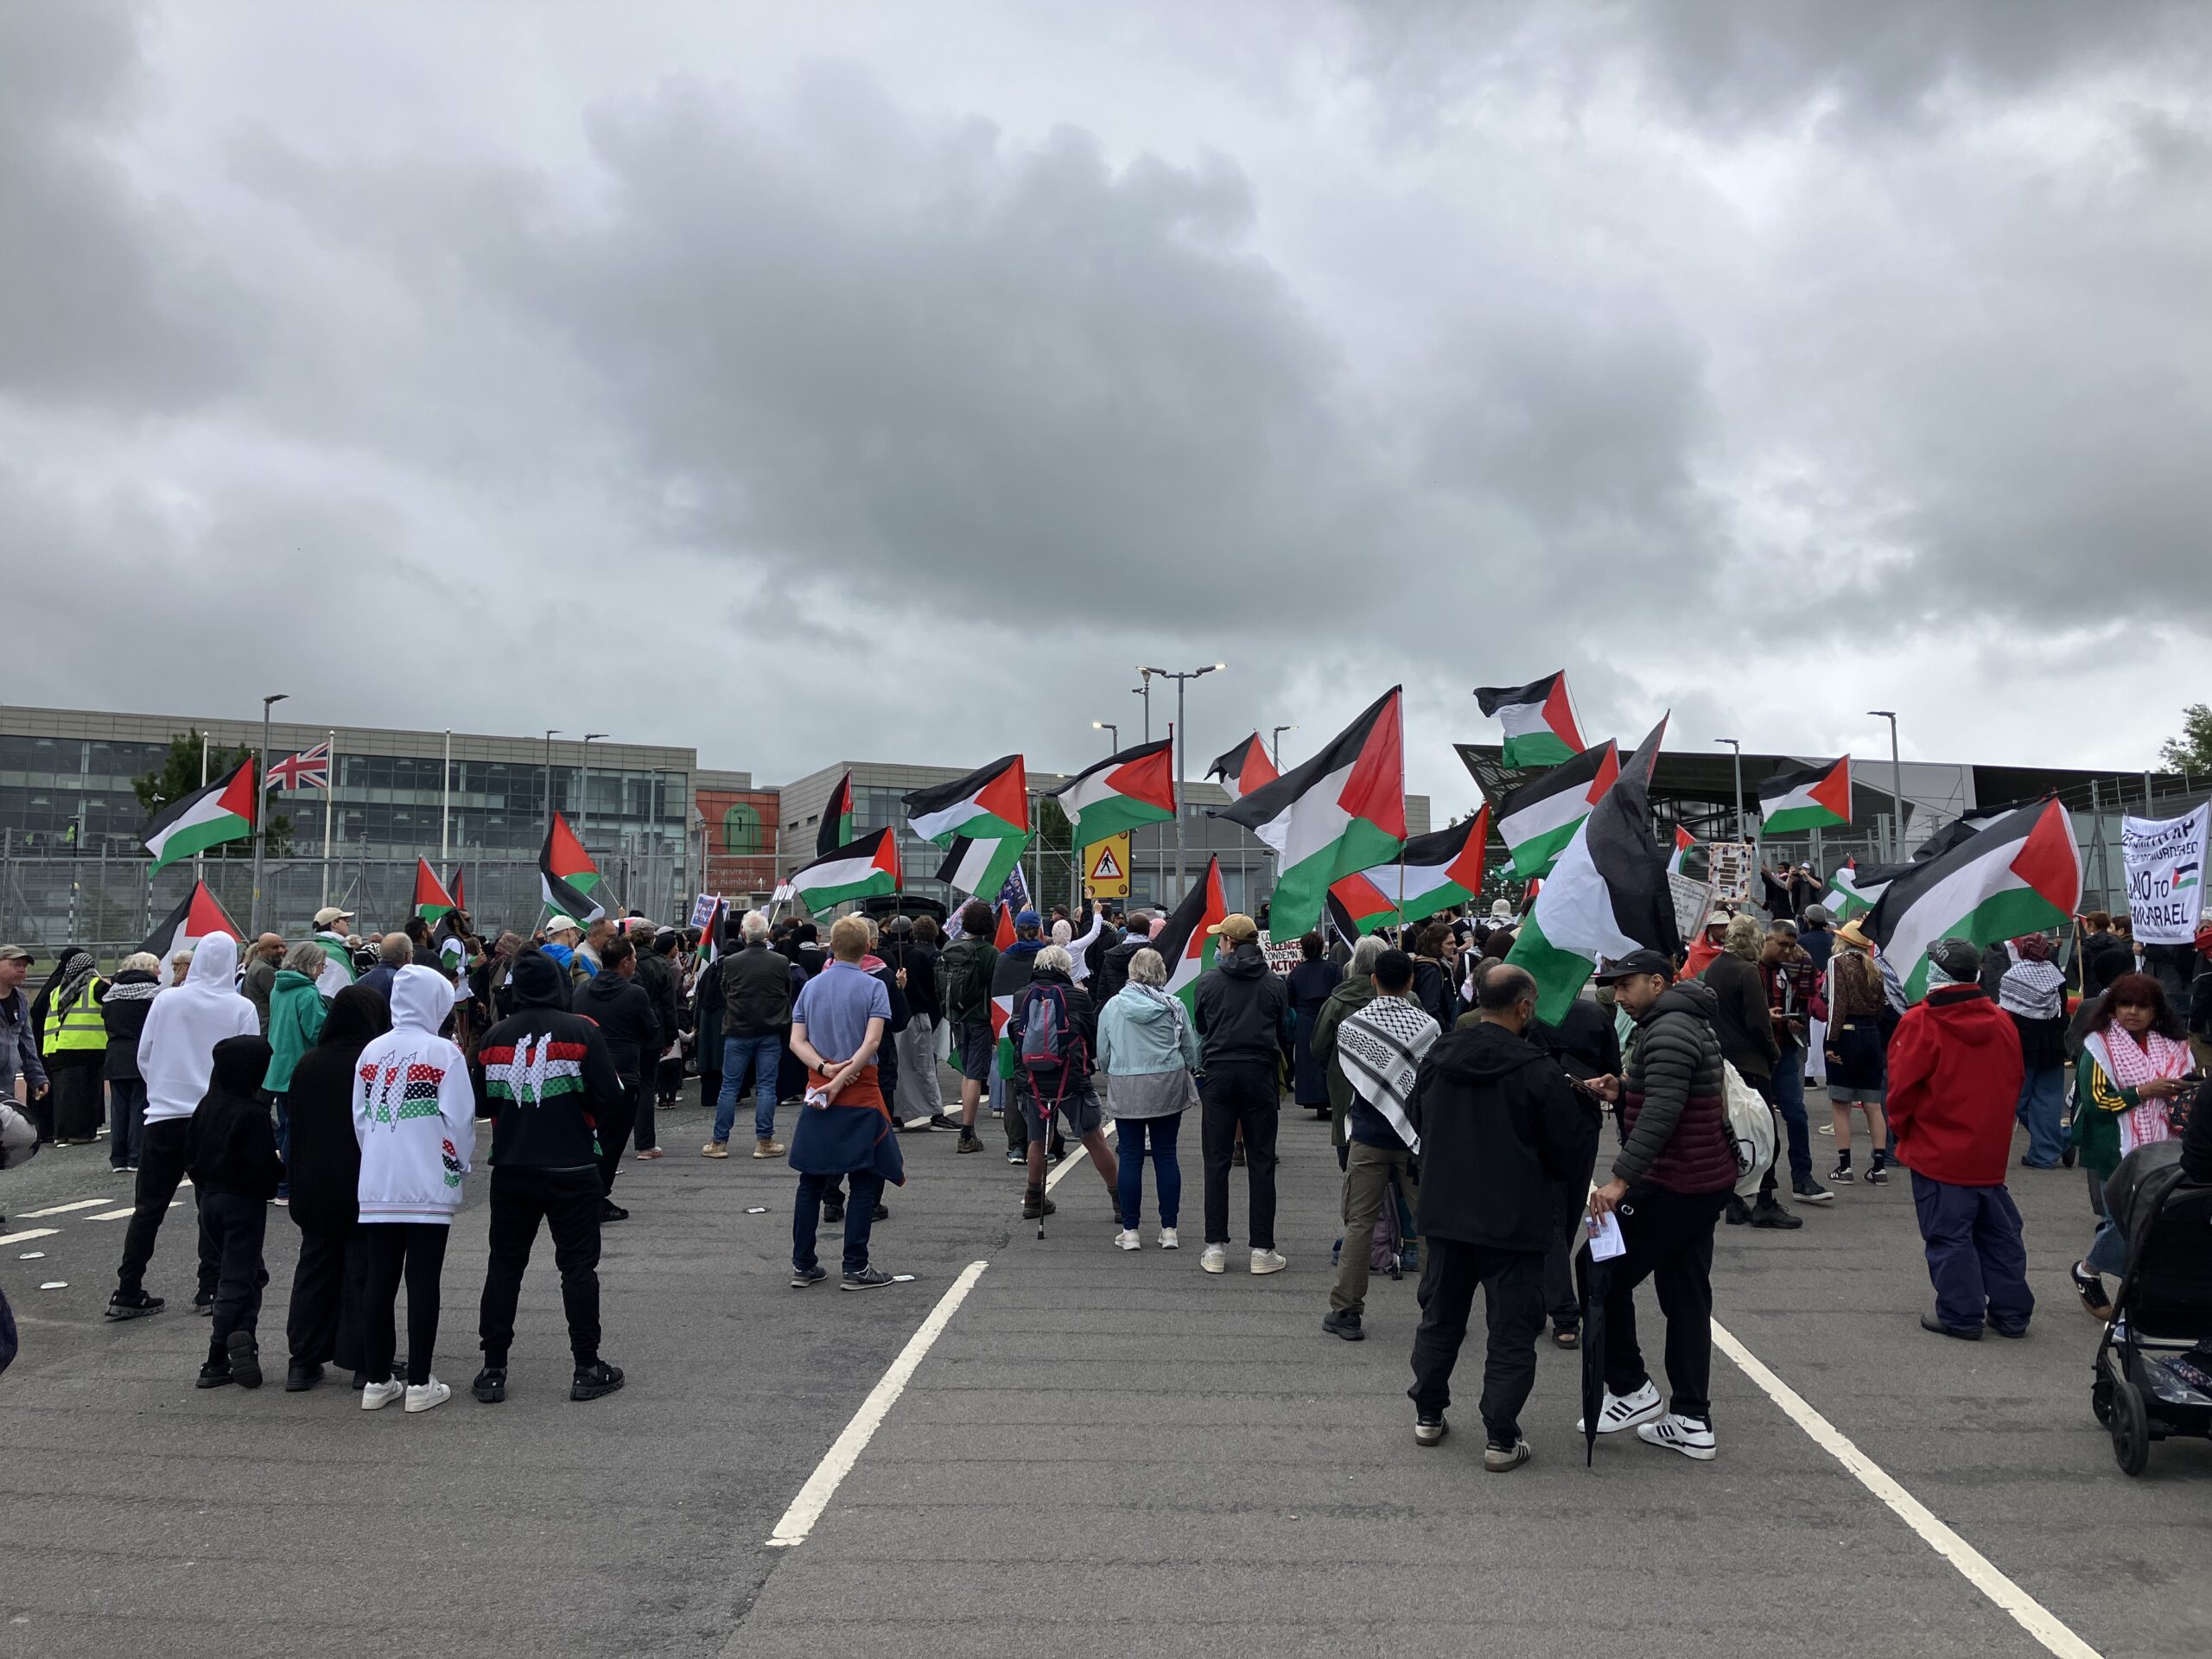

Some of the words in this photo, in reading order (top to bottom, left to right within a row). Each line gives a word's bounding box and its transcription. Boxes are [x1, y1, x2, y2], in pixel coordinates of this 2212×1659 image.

[738, 817, 742, 832] 1
[772, 884, 797, 901] NOW
[2153, 879, 2170, 899] TO
[1264, 940, 1301, 951] SILENCE
[1263, 950, 1298, 961] CONDEMN
